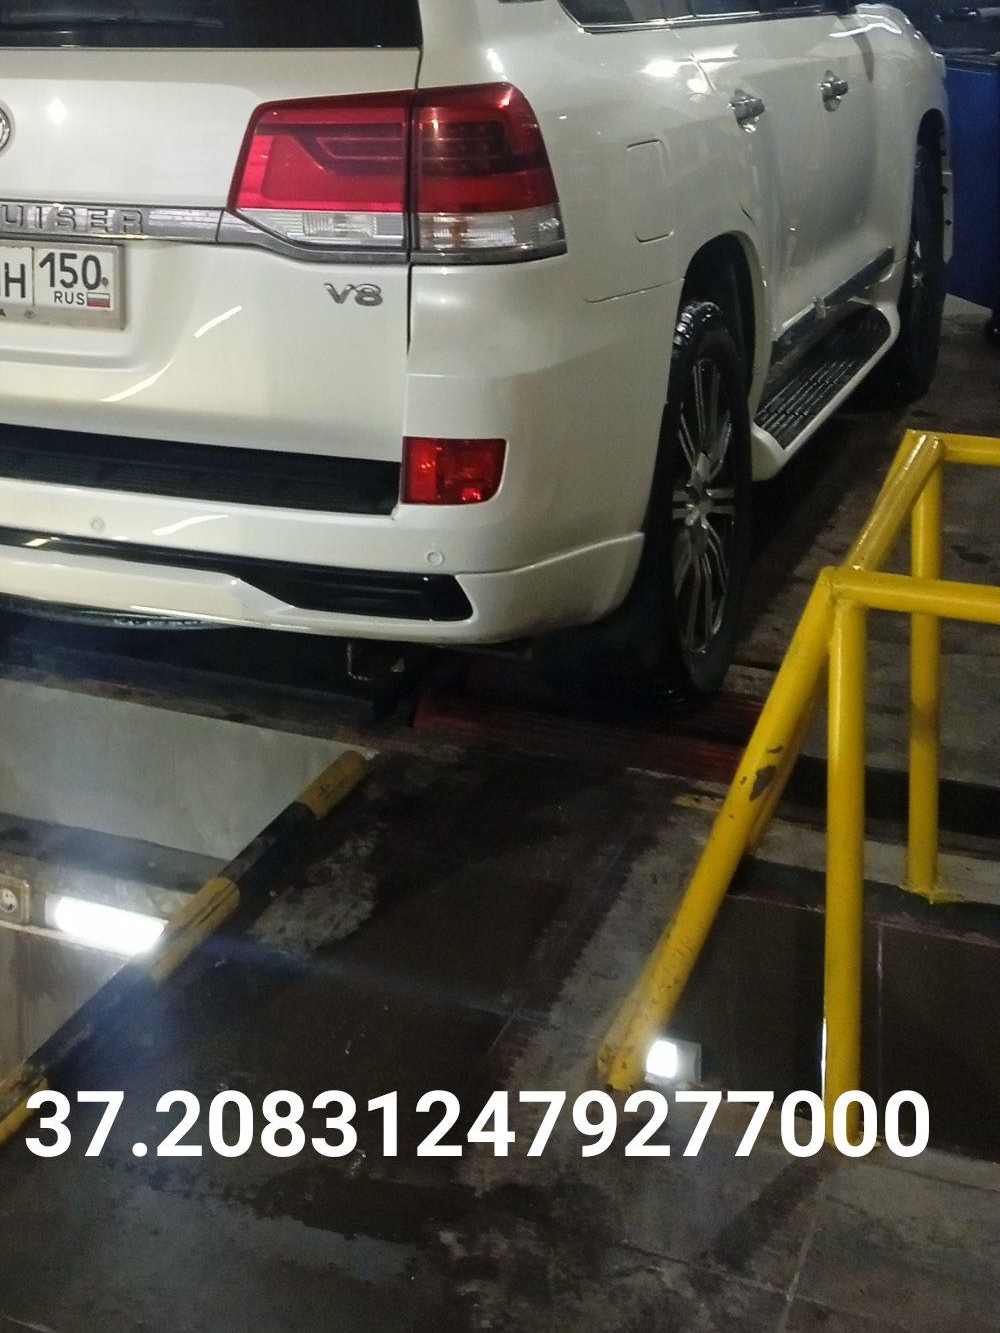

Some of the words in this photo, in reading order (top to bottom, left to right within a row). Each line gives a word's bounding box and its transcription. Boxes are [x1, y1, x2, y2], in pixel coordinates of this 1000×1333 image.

[39, 252, 102, 291] 150
[54, 290, 85, 306] RUS
[323, 282, 384, 307] V8
